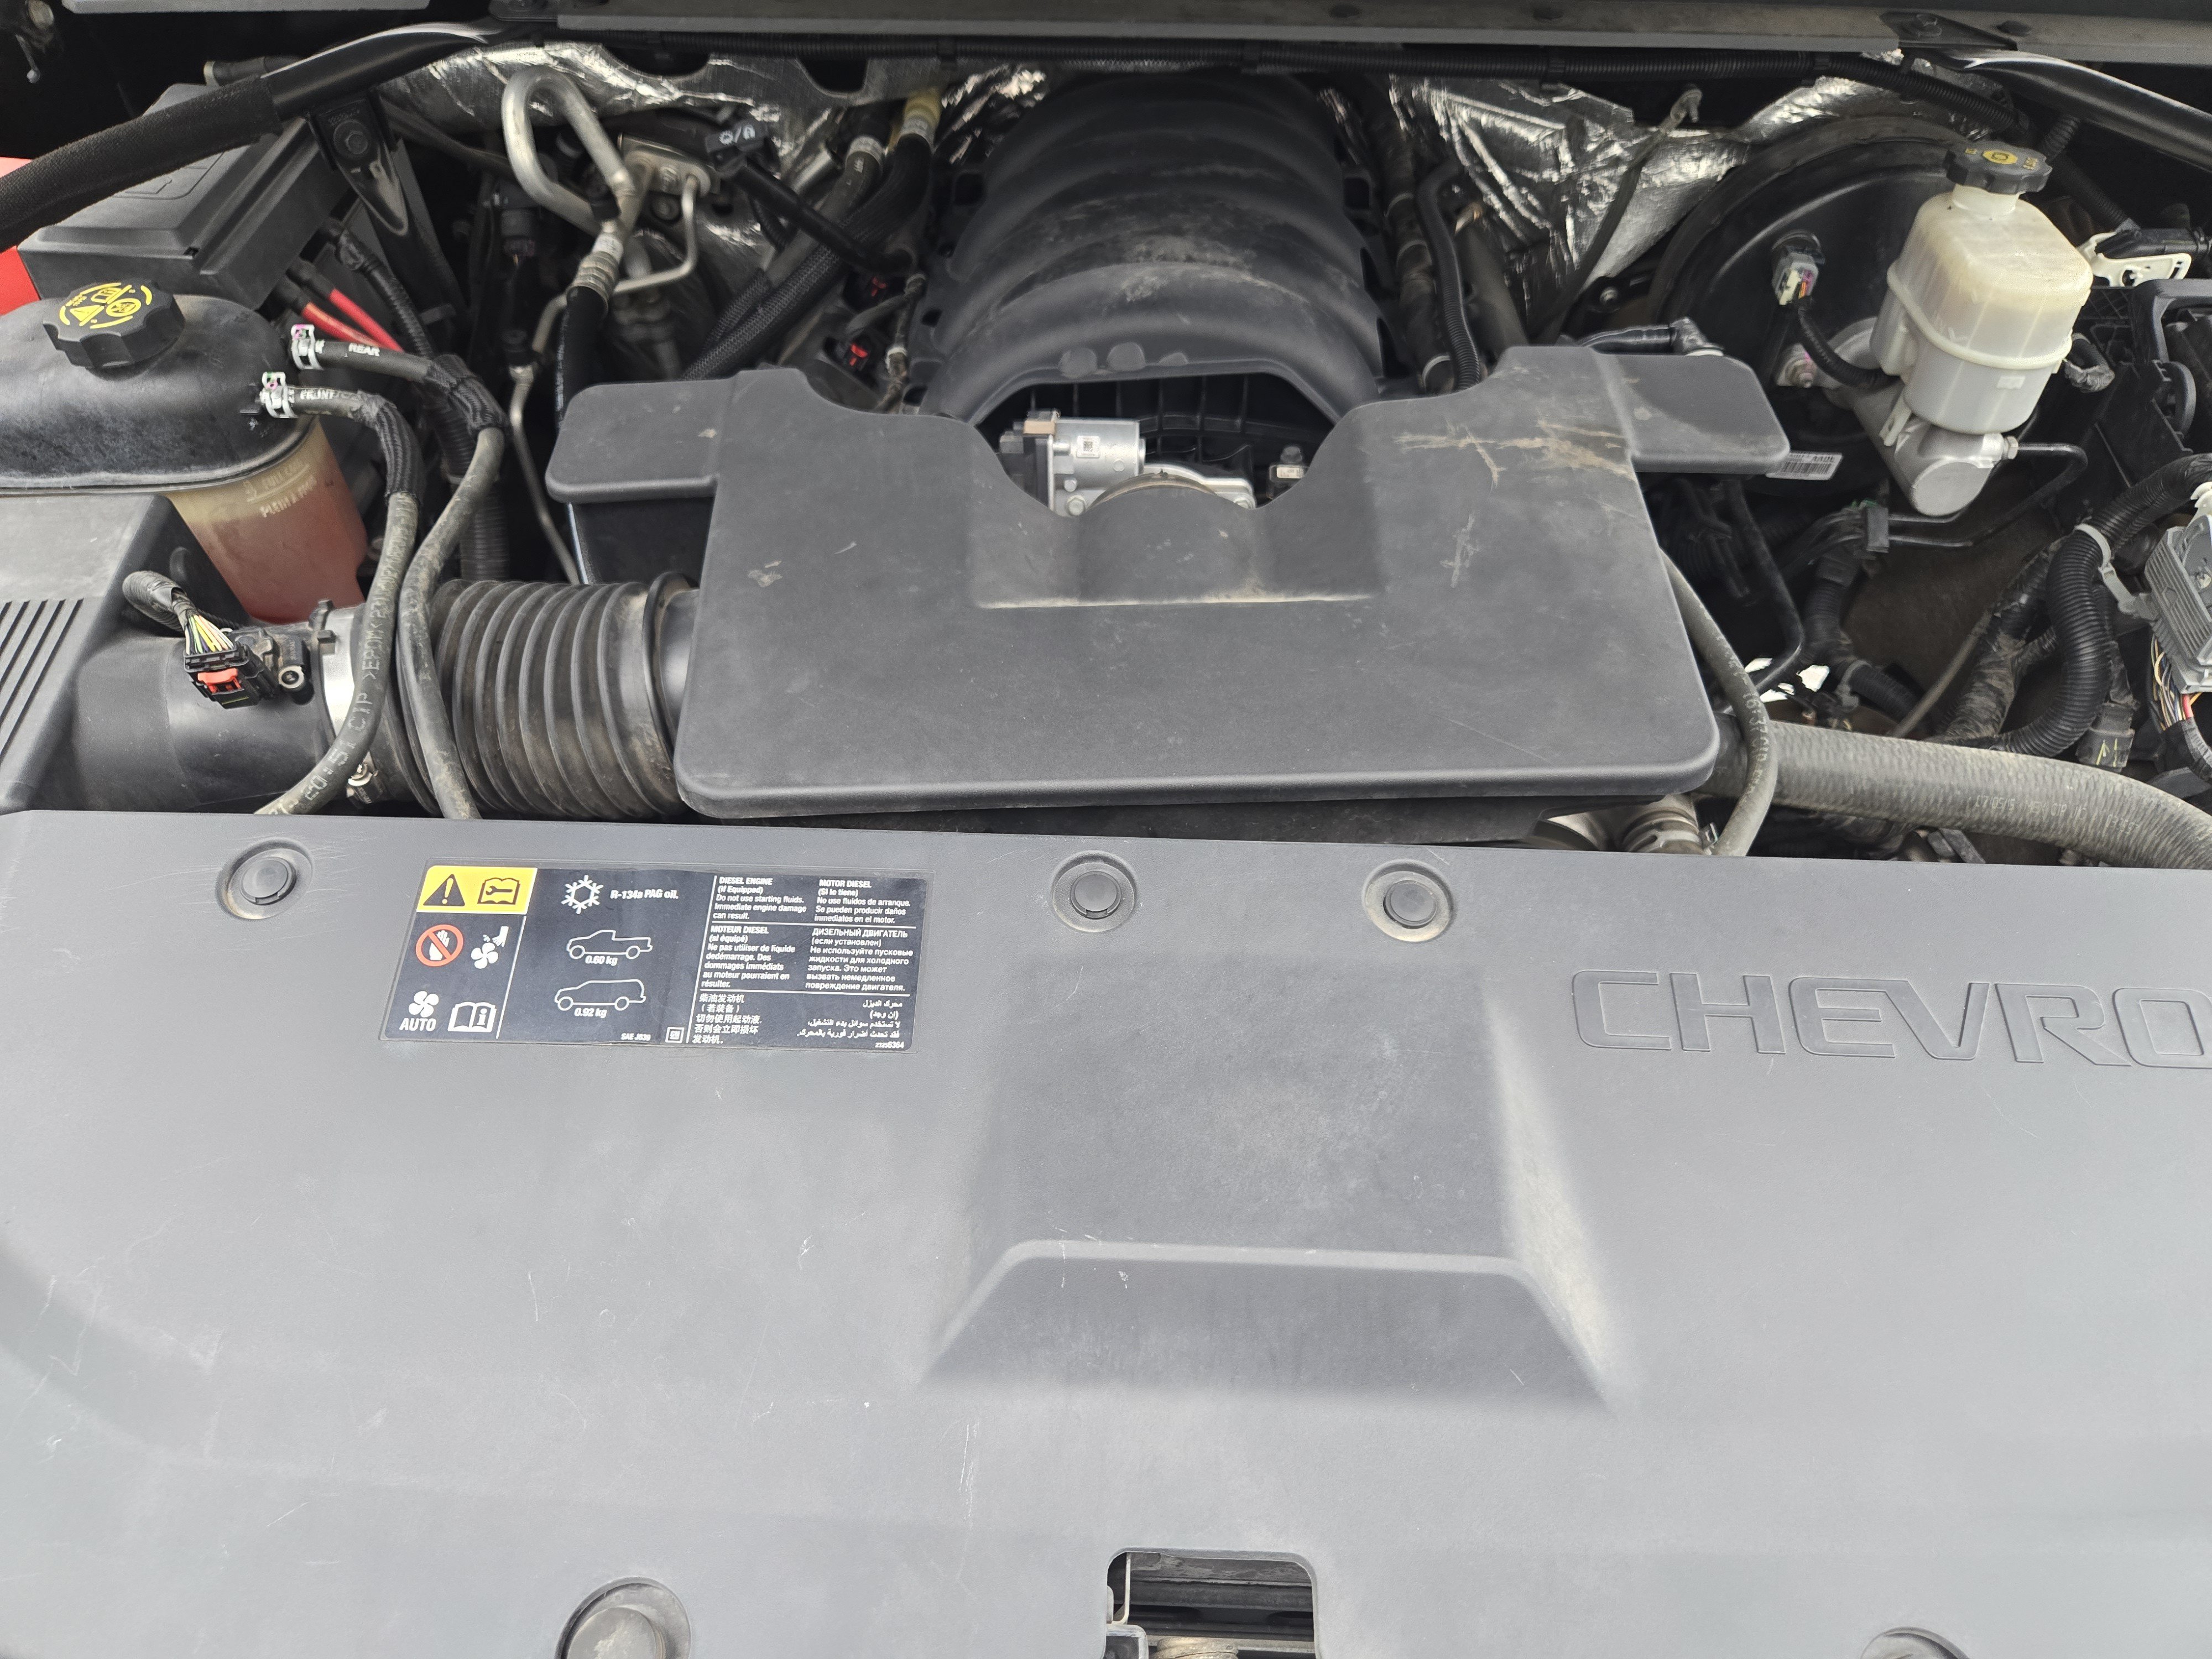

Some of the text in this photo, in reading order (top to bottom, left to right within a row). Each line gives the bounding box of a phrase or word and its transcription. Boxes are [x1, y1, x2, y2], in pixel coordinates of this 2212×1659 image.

[349, 343, 380, 357] REAR
[300, 389, 335, 400] FRONT
[611, 889, 679, 899] R-134a PAG oil.
[717, 885, 764, 895] (If Equipped)
[838, 889, 858, 898] tiene)
[754, 895, 781, 904] starting
[753, 904, 777, 912] engine
[778, 905, 807, 913] damage
[814, 914, 853, 922] inmediatos
[711, 925, 742, 933] MOTEUR
[812, 928, 908, 938] ДИЗЕЛЬНЫЙ ДВИГАТЕЛЬ
[720, 935, 748, 943] équipé)
[834, 939, 881, 947] установлен)
[771, 945, 795, 953] liquide
[585, 955, 618, 966] 0.60 kg
[704, 961, 784, 971] dommages immédiats
[574, 1008, 607, 1018] 0.92 kg
[399, 1018, 436, 1032] AUTO
